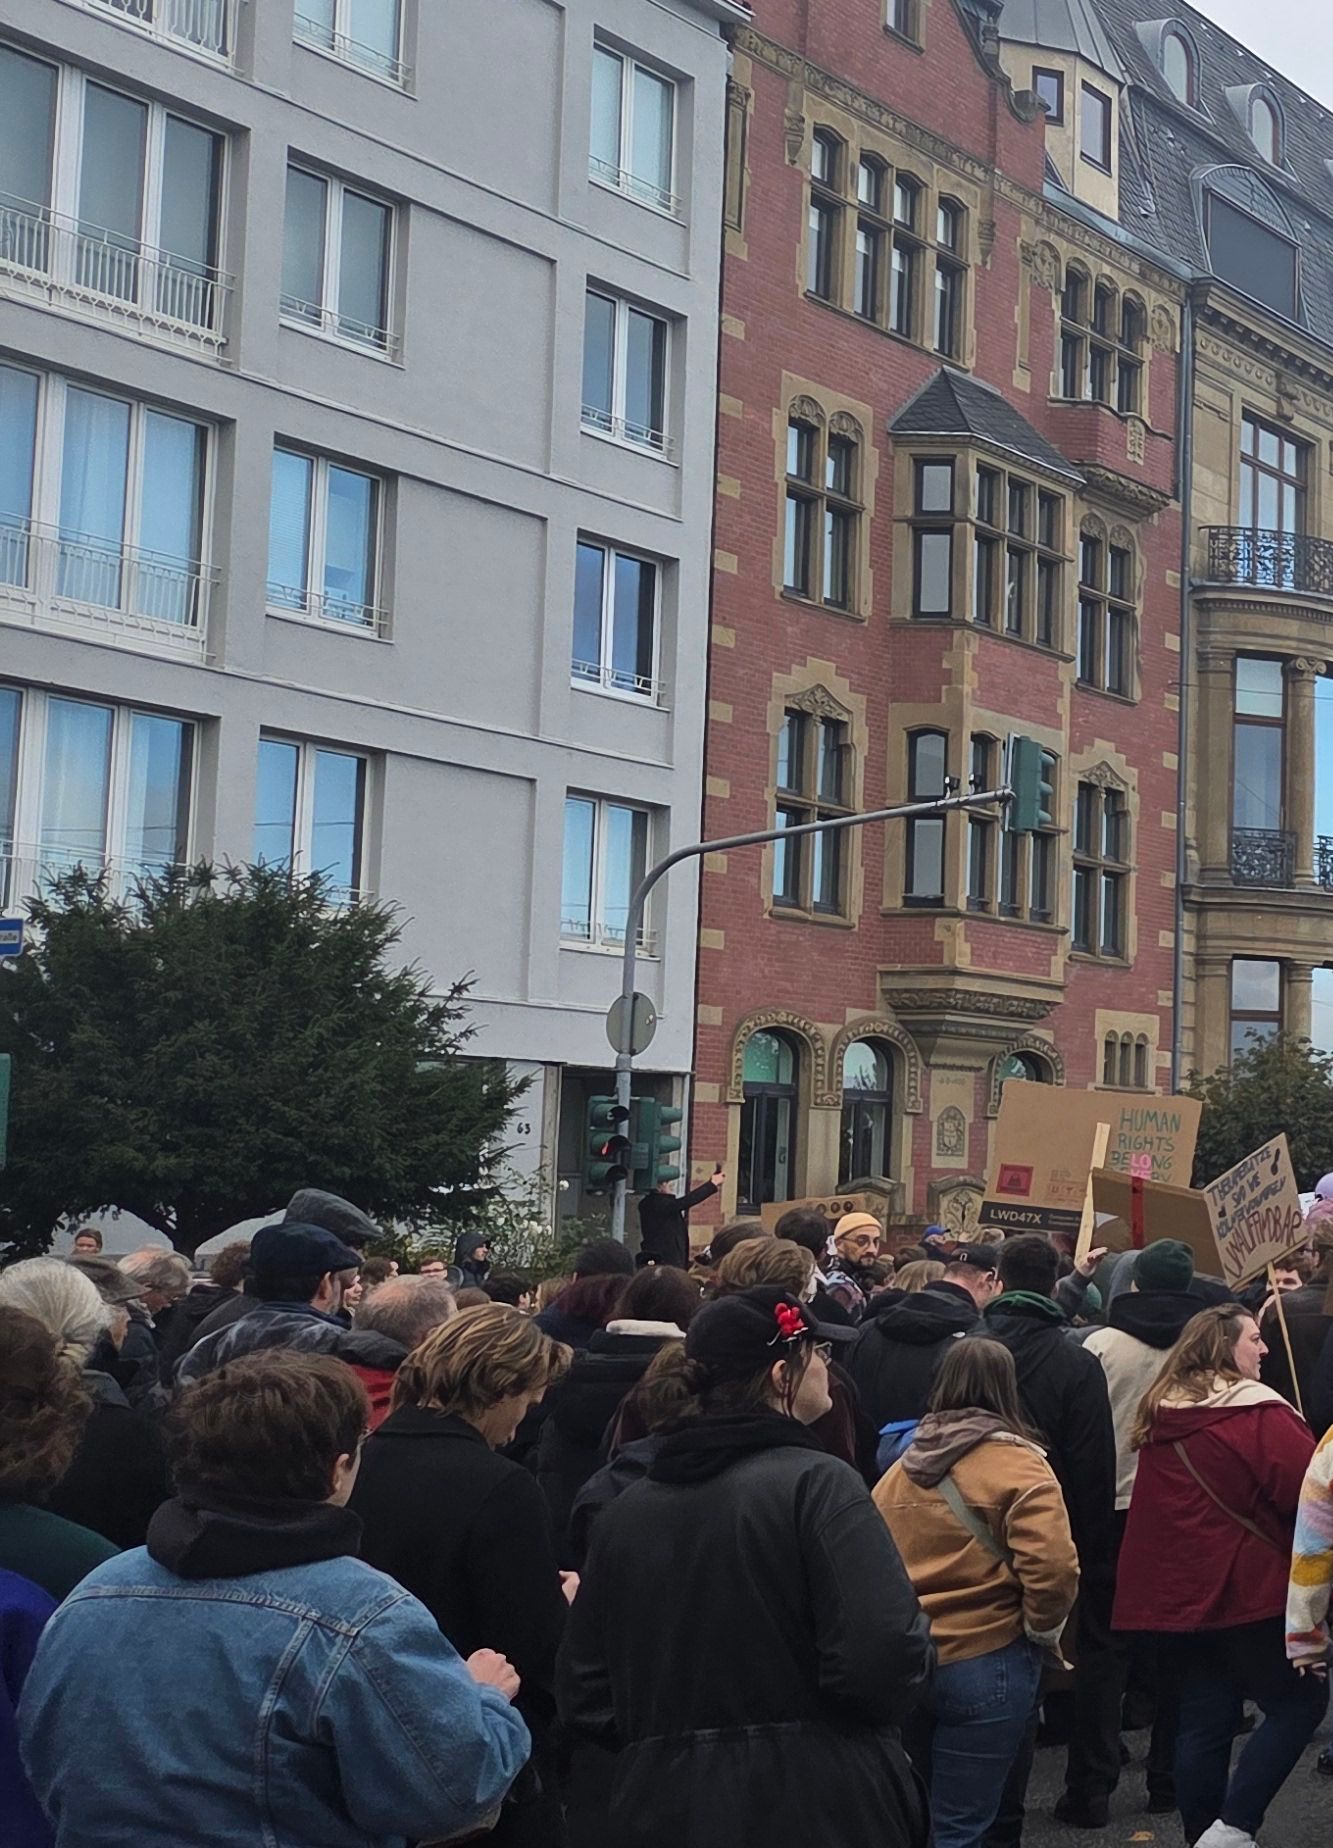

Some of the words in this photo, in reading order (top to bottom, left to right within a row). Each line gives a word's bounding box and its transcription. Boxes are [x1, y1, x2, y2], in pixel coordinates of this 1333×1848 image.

[517, 1122, 531, 1135] 63
[1120, 1108, 1181, 1133] HUMAN
[1118, 1132, 1175, 1151] RIGHTS
[1110, 1151, 1172, 1170] BELONG
[990, 1208, 1043, 1225] LWD47X
